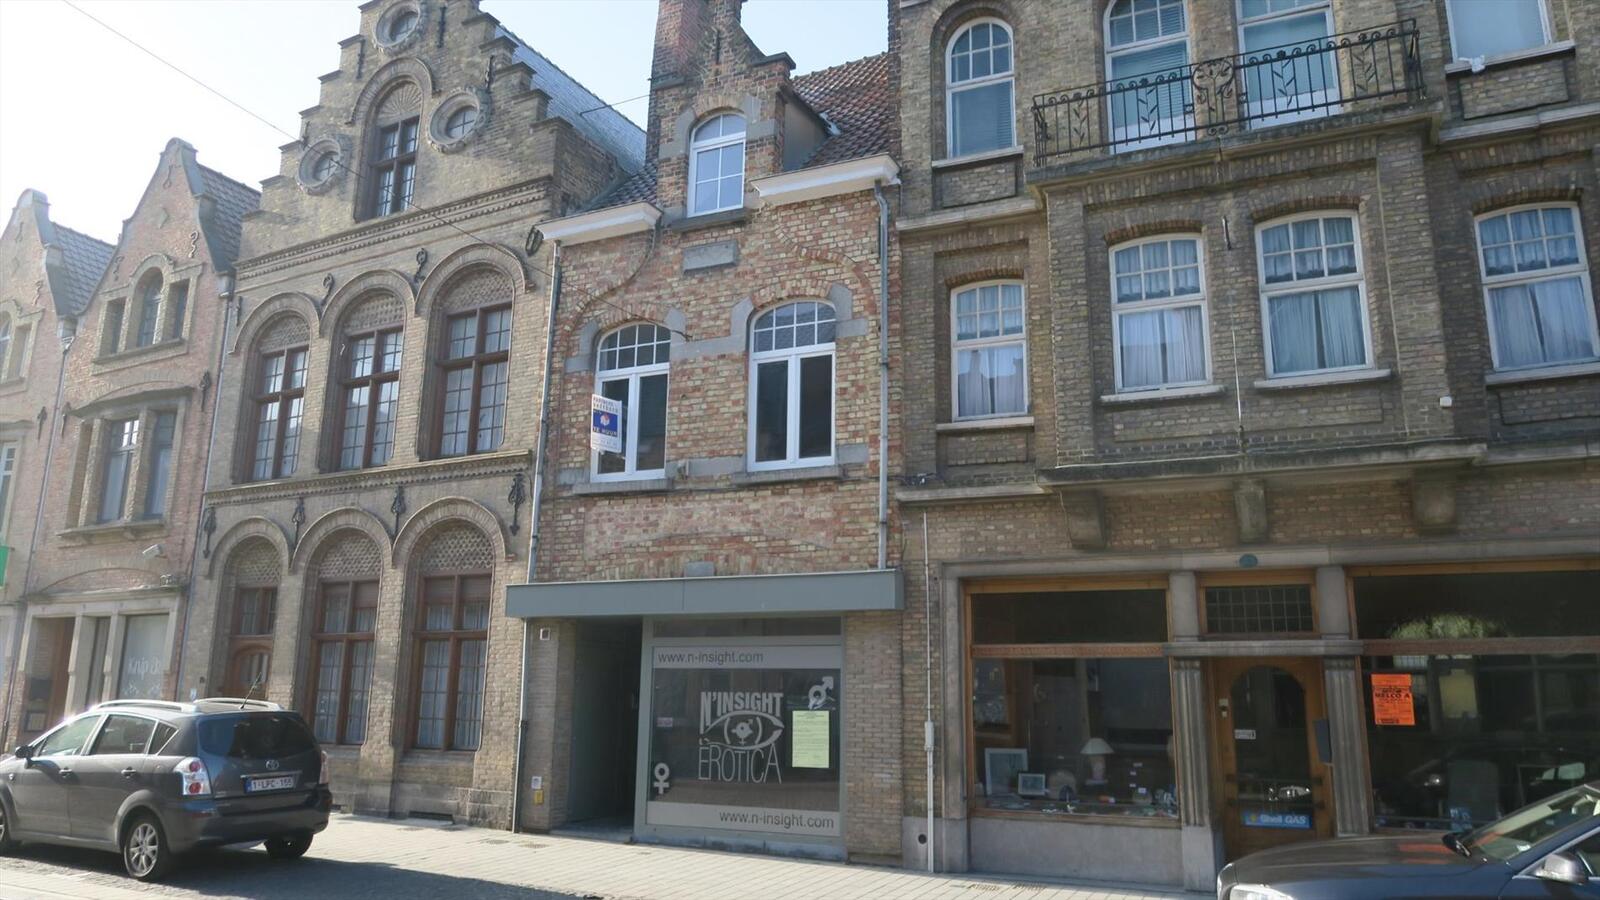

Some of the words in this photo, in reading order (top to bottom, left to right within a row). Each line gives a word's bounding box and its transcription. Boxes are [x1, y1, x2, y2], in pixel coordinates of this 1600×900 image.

[658, 652, 764, 666] www.n-insight.com
[699, 691, 784, 735] N'INSIGHT
[698, 743, 782, 784] EROTICA
[719, 811, 835, 829] www.n-insight.com
